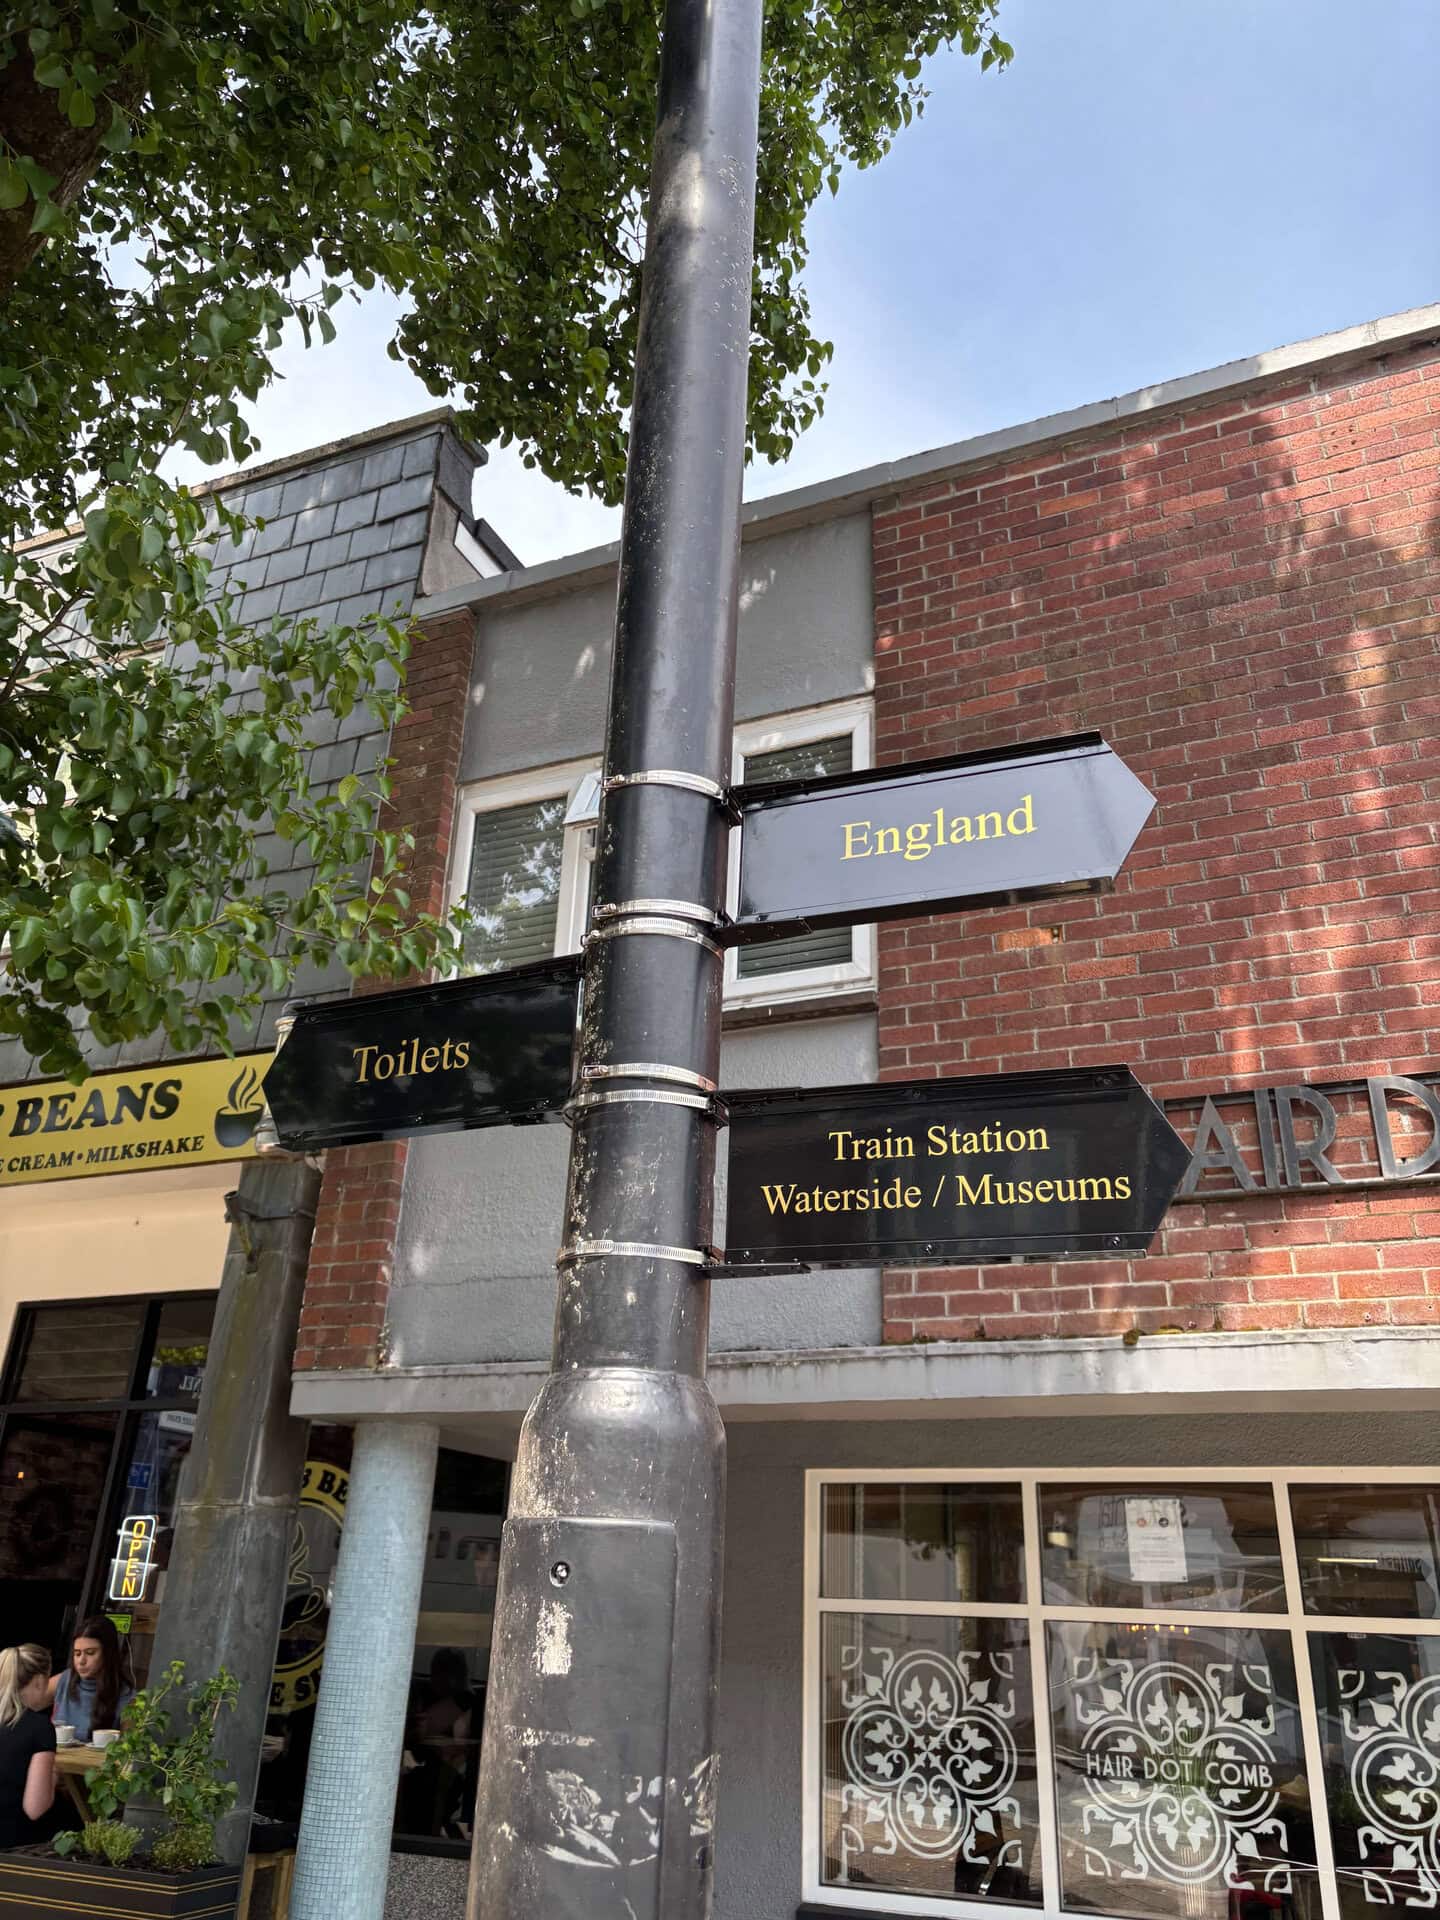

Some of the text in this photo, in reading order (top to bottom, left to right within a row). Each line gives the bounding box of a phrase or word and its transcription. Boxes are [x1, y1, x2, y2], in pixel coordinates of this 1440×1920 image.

[841, 795, 1037, 861] England
[353, 1037, 470, 1083] Toilets
[9, 1079, 182, 1137] BEANS
[7, 1150, 75, 1172] CREAM
[86, 1135, 204, 1164] MILKSHAKE
[828, 1121, 1050, 1161] Train Station
[1179, 1086, 1345, 1194] AIR
[761, 1177, 922, 1215] Waterside
[955, 1173, 1132, 1208] Museums
[121, 1521, 146, 1596] OPEN
[1086, 1753, 1273, 1788] HAIR DOT COMB
